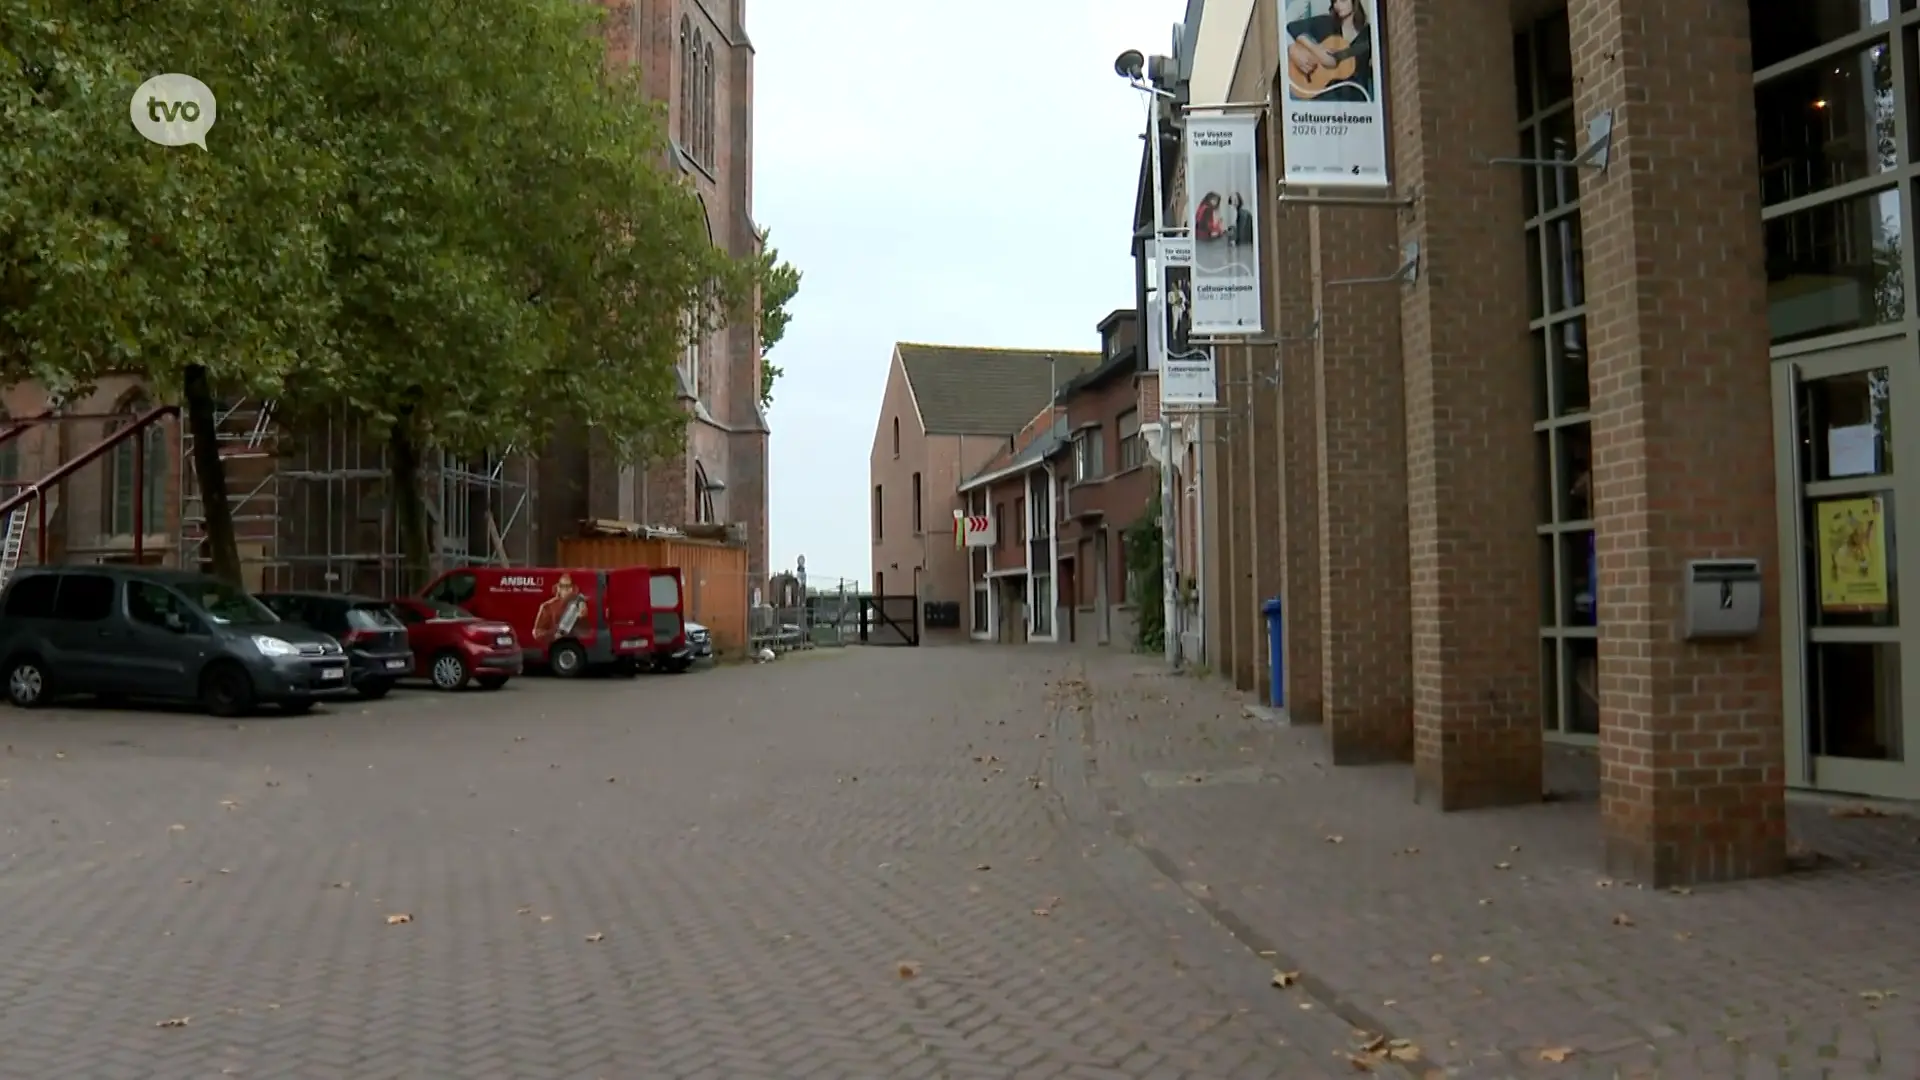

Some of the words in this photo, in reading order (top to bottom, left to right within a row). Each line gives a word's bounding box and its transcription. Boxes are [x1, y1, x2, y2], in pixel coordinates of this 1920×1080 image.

[1291, 112, 1373, 124] Cultuurseizoen
[1292, 126, 1317, 136] 2026
[1325, 125, 1349, 136] 2027
